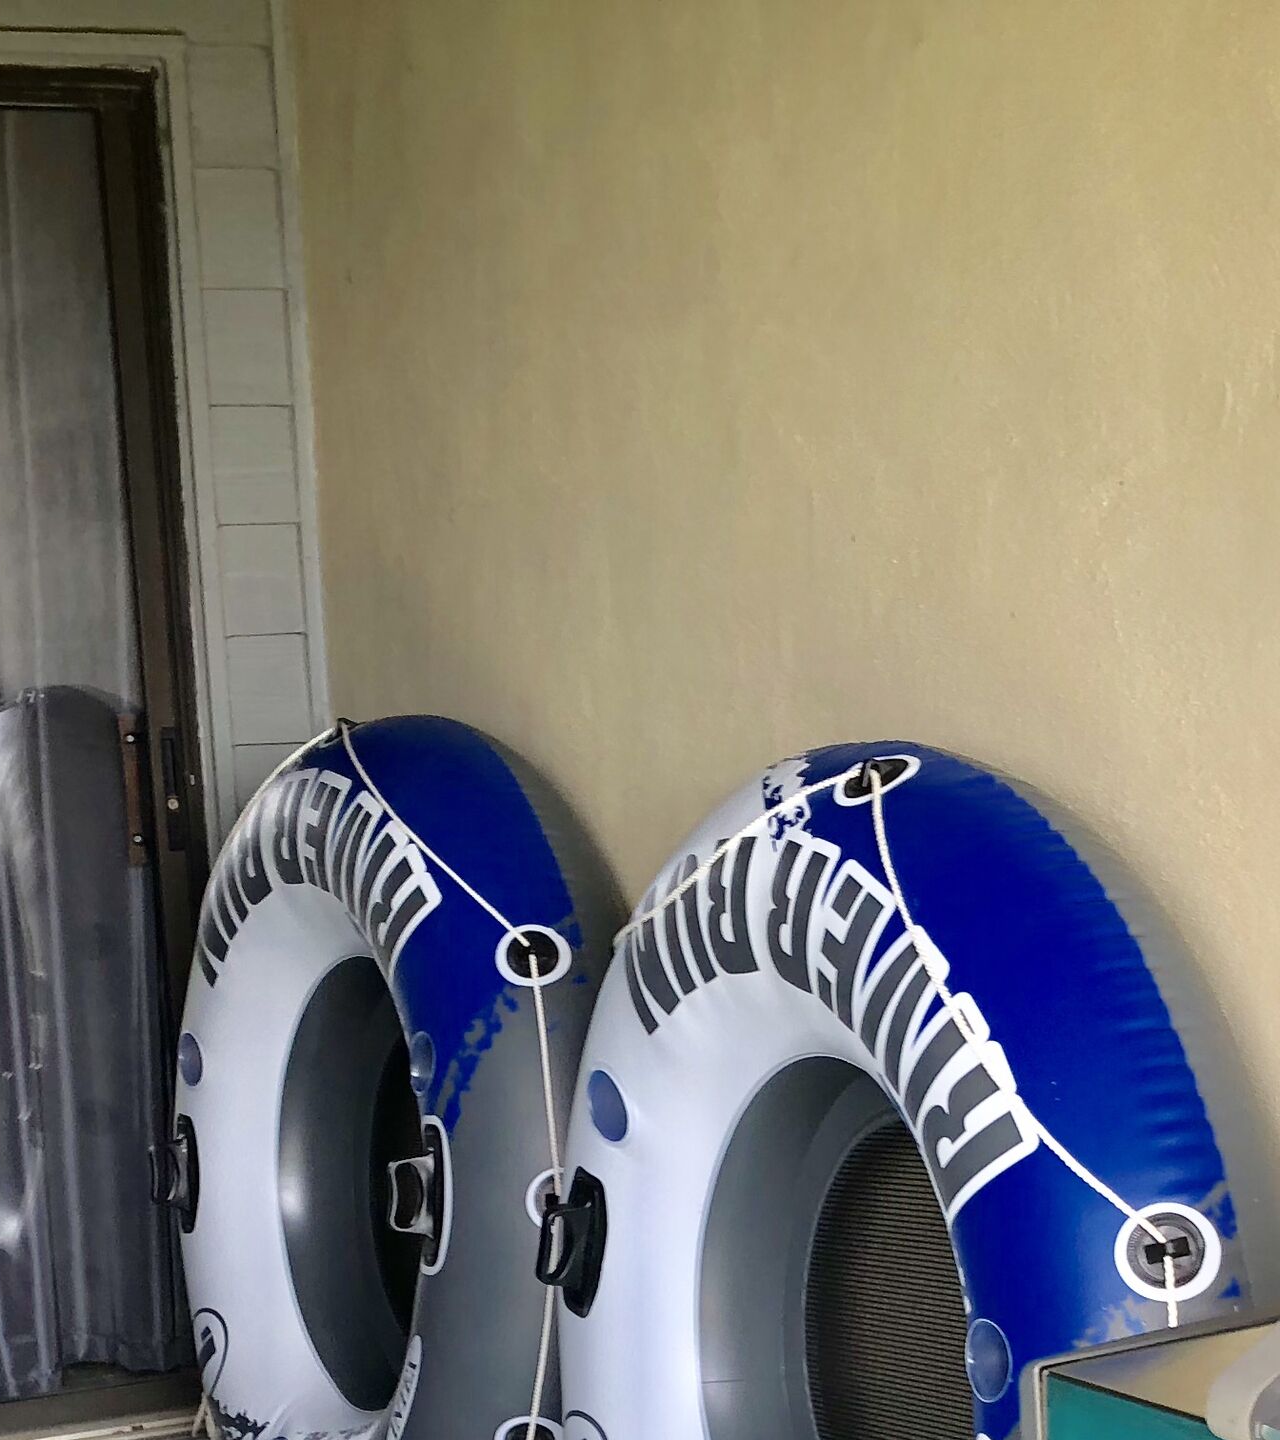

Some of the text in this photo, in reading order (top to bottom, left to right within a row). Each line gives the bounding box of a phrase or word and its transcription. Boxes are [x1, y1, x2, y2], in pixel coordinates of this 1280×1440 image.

[272, 772, 434, 972] RIVER
[624, 836, 1026, 1214] RIVER RUN
